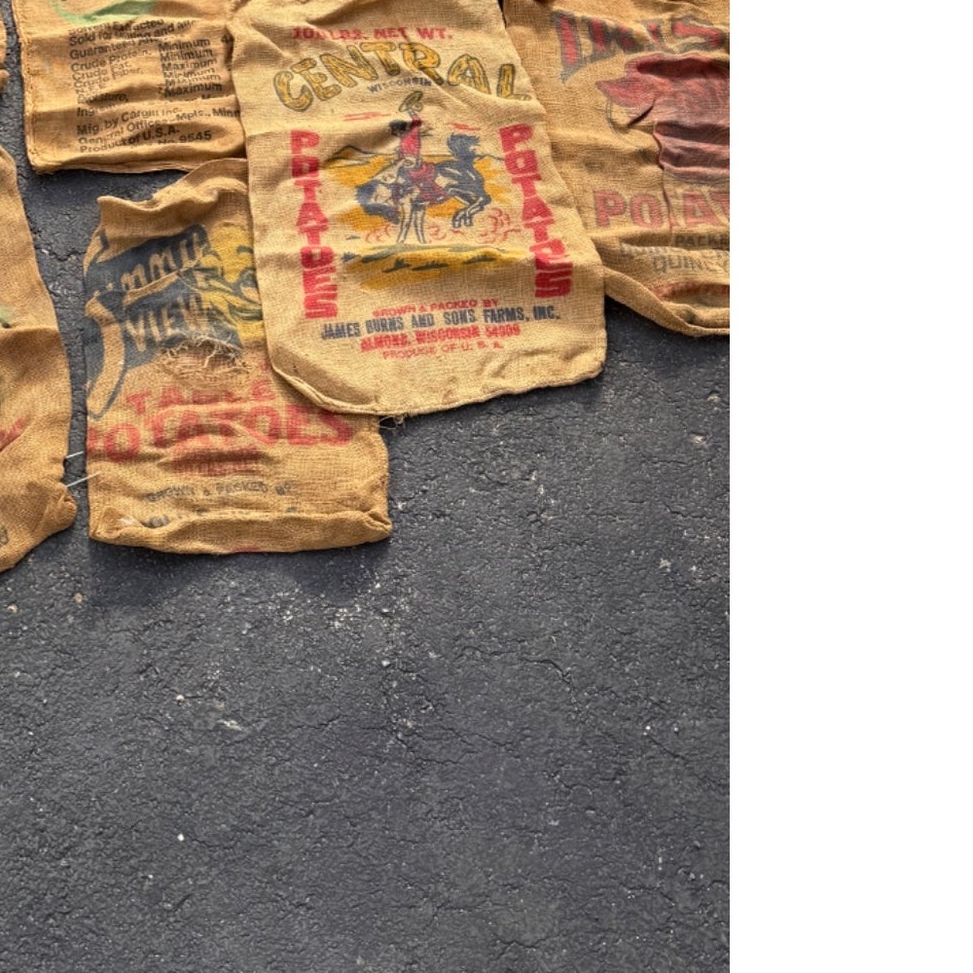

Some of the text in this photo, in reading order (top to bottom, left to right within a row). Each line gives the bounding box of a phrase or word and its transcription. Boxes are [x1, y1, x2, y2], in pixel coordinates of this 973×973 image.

[68, 32, 96, 47] Sold
[373, 27, 407, 40] NET
[416, 27, 454, 40] WT.
[70, 59, 107, 73] Crude
[158, 37, 211, 53] Minimum
[159, 48, 213, 63] Minimum
[161, 58, 218, 73] Maximum
[273, 41, 532, 113] CENTRAL
[367, 76, 433, 93] WISCONSIN
[164, 82, 223, 97] Maximum
[104, 117, 119, 129] by
[128, 134, 140, 145] of
[142, 126, 180, 141] U.S.A.
[429, 300, 477, 313] PACKED
[482, 298, 499, 309] BY
[320, 321, 361, 341] JAMES
[365, 315, 404, 335] BURNS
[411, 312, 435, 329] AND
[443, 309, 477, 326] SONS
[533, 305, 561, 321] INC.
[415, 324, 481, 345] WISCONSIN
[442, 343, 459, 355] OF
